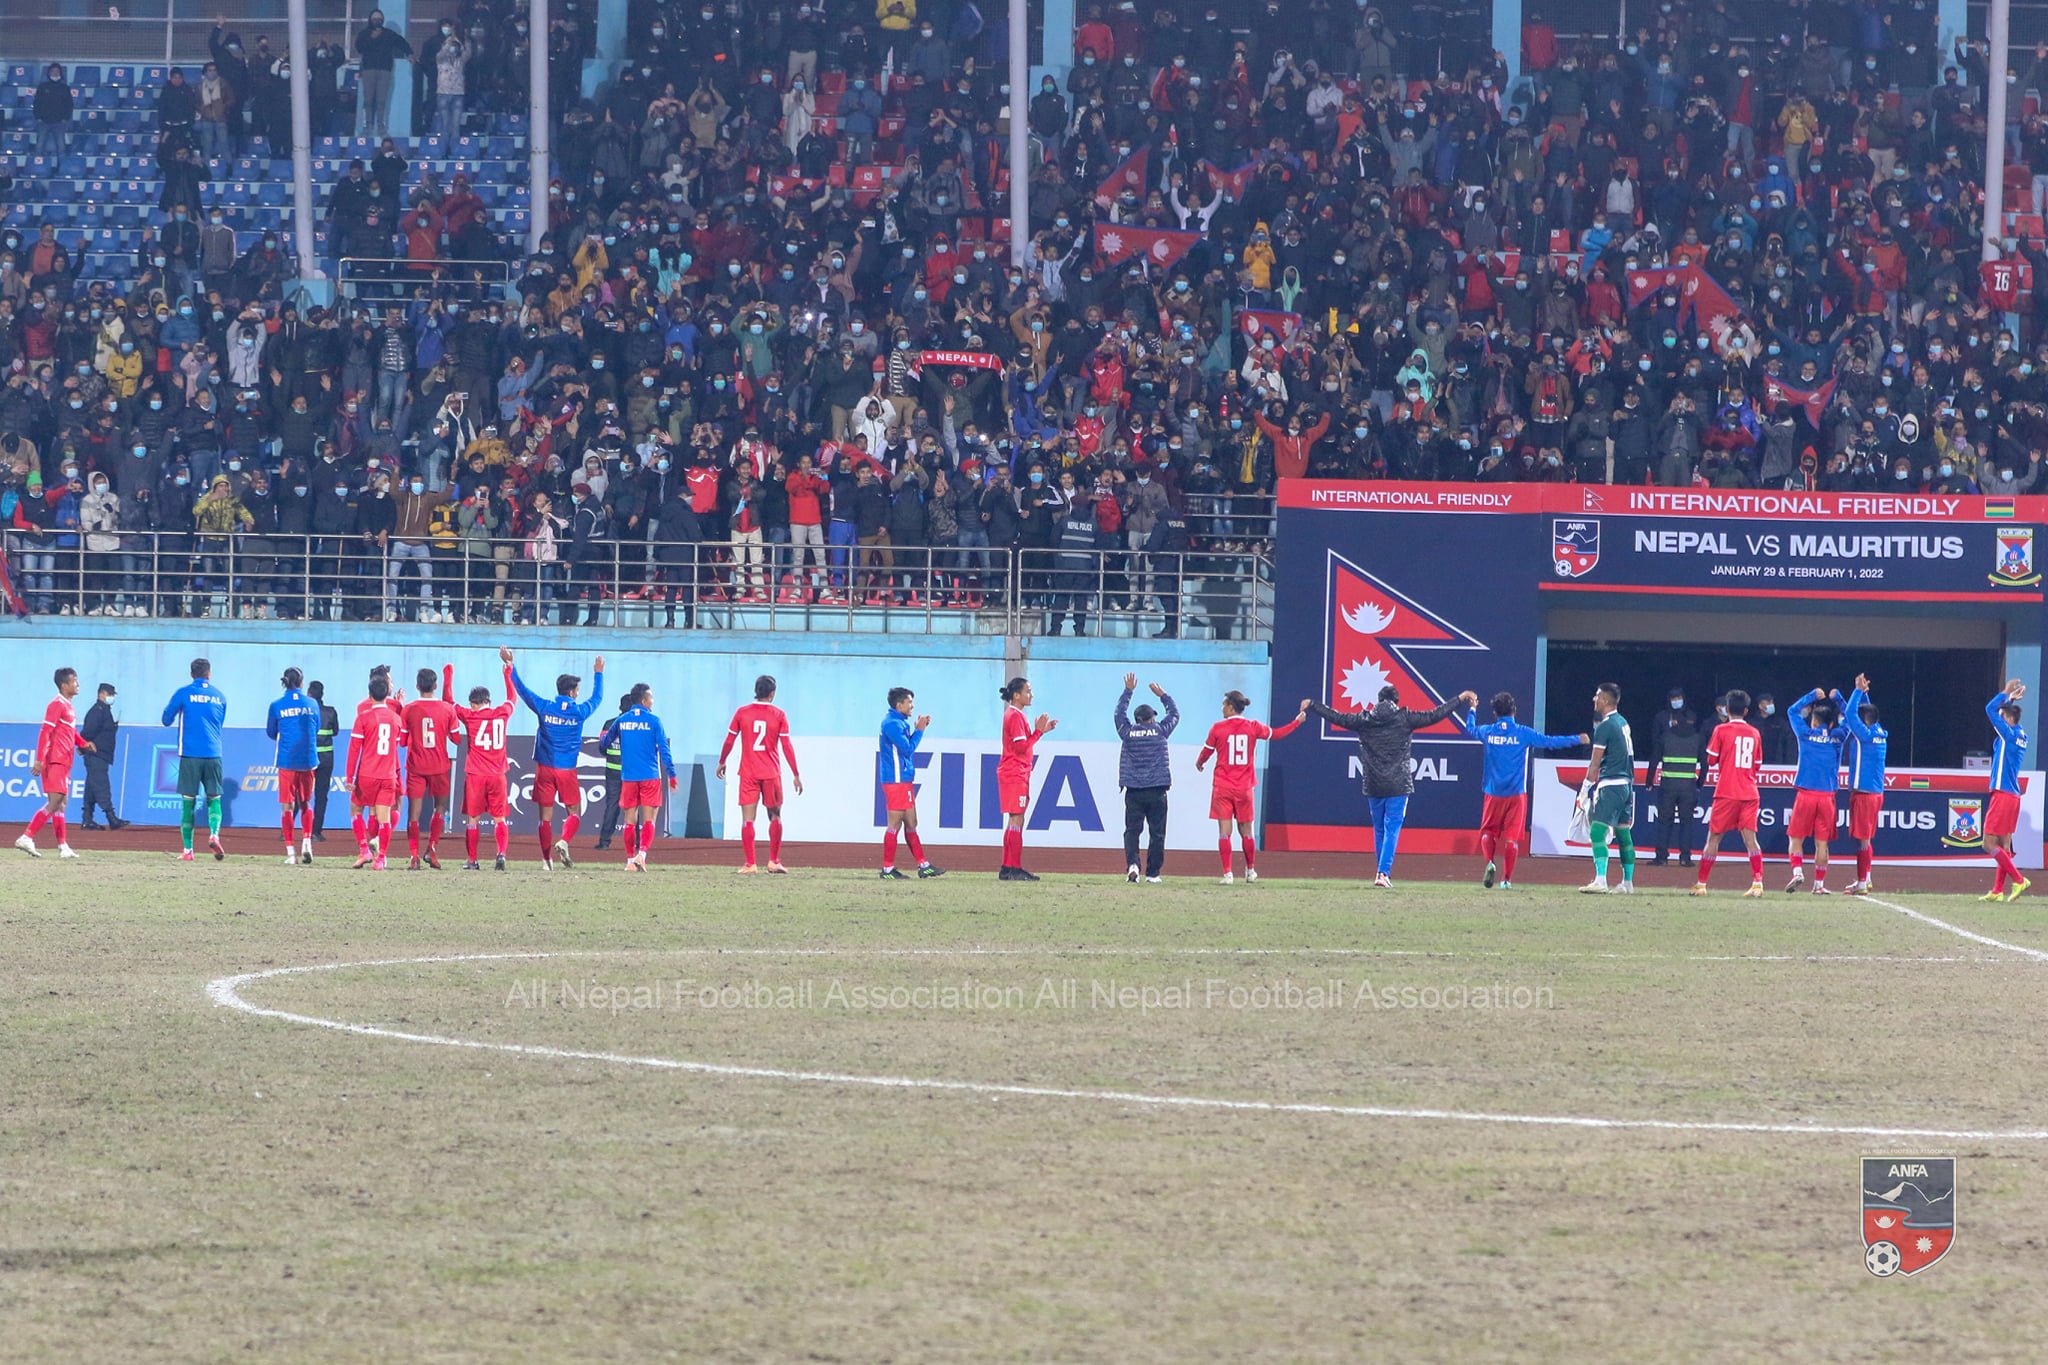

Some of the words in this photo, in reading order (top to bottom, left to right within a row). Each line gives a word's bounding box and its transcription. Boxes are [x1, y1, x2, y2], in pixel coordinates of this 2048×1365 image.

[1994, 271, 2010, 292] 16
[936, 352, 976, 363] NEPAL
[1311, 489, 1433, 505] INTERNATIONAL
[1437, 492, 1512, 506] FRIENDLY
[1630, 492, 1831, 514] INTERNATIONAL
[1838, 497, 1960, 516] FRIENDLY
[1567, 522, 1587, 531] ANFA
[1634, 530, 1737, 555] NEPAL
[1745, 534, 1780, 557] VS
[1790, 534, 1964, 559] MAURITIUS
[1711, 565, 1761, 576] JANUARY
[1764, 567, 1776, 576] 29
[1778, 567, 1786, 577] &
[1788, 567, 1845, 578] FEBRUARY
[1848, 569, 1857, 579] 1,
[1859, 568, 1884, 579] 2022
[189, 694, 223, 705] NEPAL
[280, 707, 314, 718] NEPAL
[544, 715, 579, 726] NEPAL
[421, 717, 436, 749] 6
[474, 718, 505, 751] 40
[620, 722, 651, 731] NEPAL
[1129, 729, 1159, 738] NEPAL
[376, 723, 391, 755] 8
[752, 720, 767, 752] 2
[1487, 734, 1520, 745] NEPAL
[1227, 734, 1249, 766] 19
[1734, 736, 1755, 769] 18
